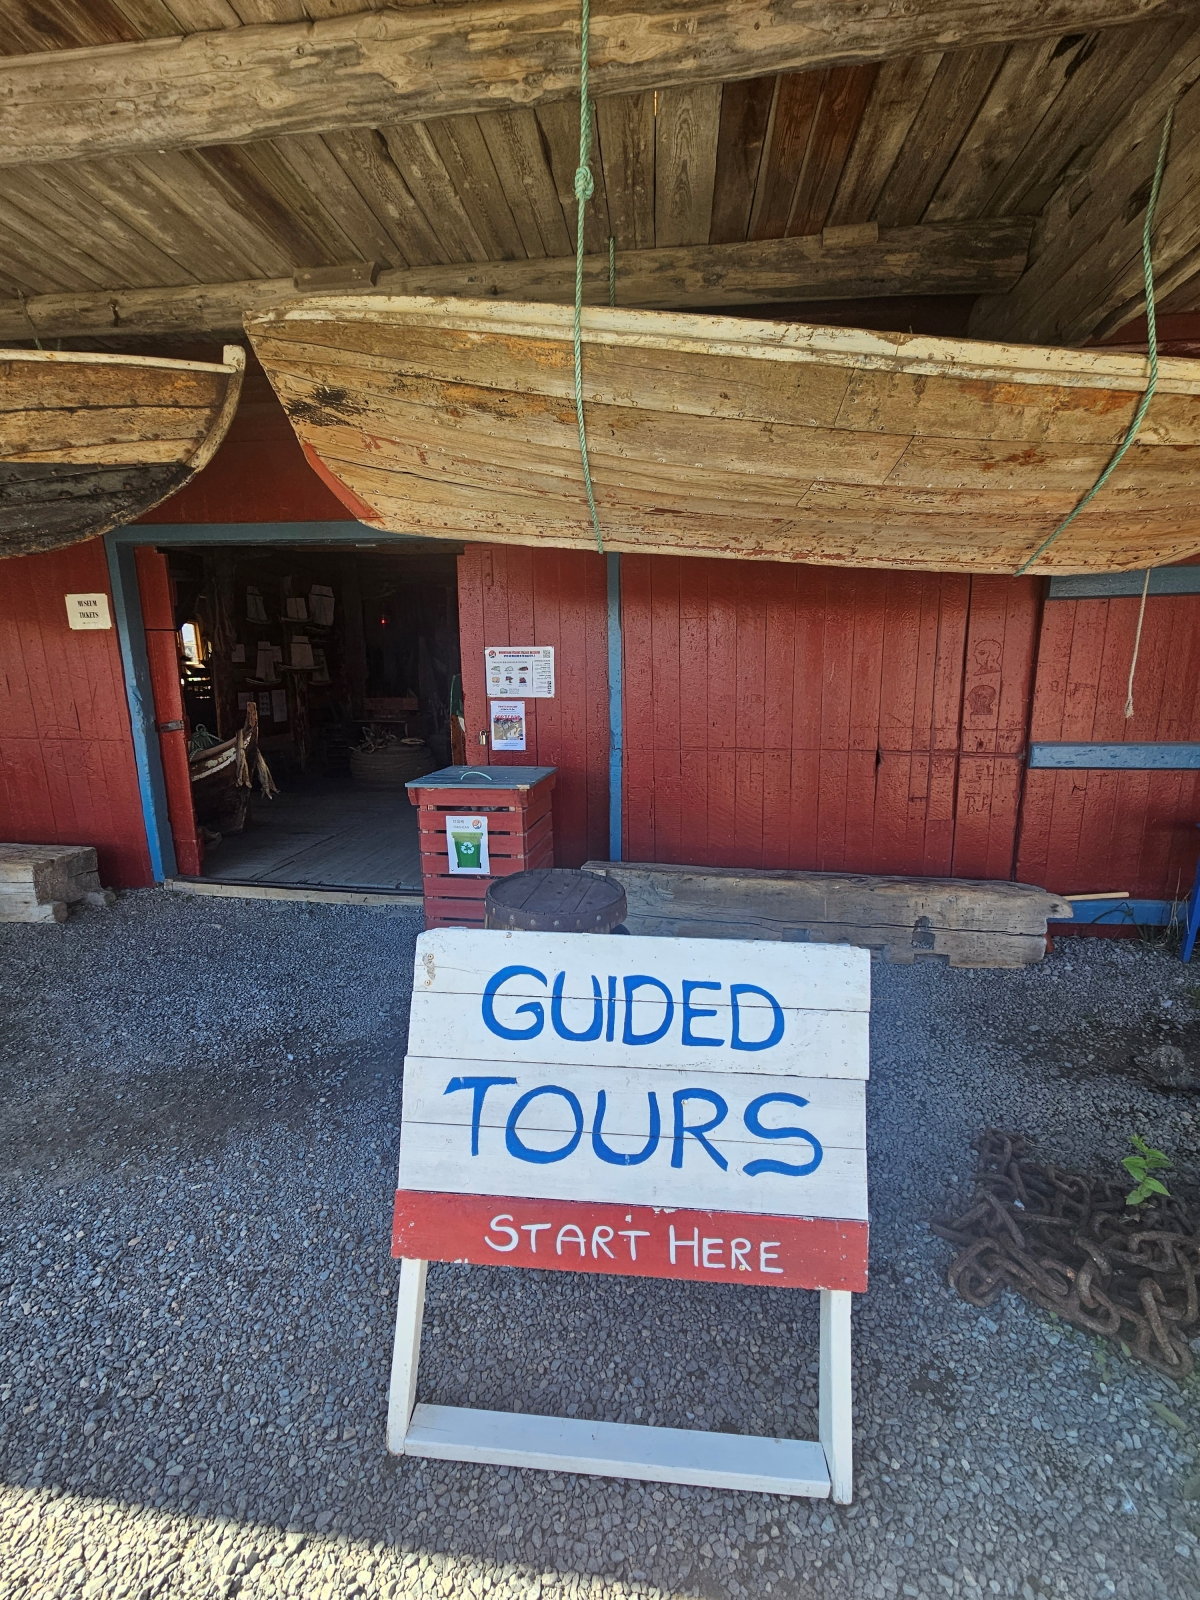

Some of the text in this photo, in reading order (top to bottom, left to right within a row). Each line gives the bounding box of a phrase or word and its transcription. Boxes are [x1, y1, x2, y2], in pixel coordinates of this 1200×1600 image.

[482, 965, 785, 1052] GUIDED
[443, 1076, 823, 1178] TOURS
[484, 1214, 785, 1274] START HERE
